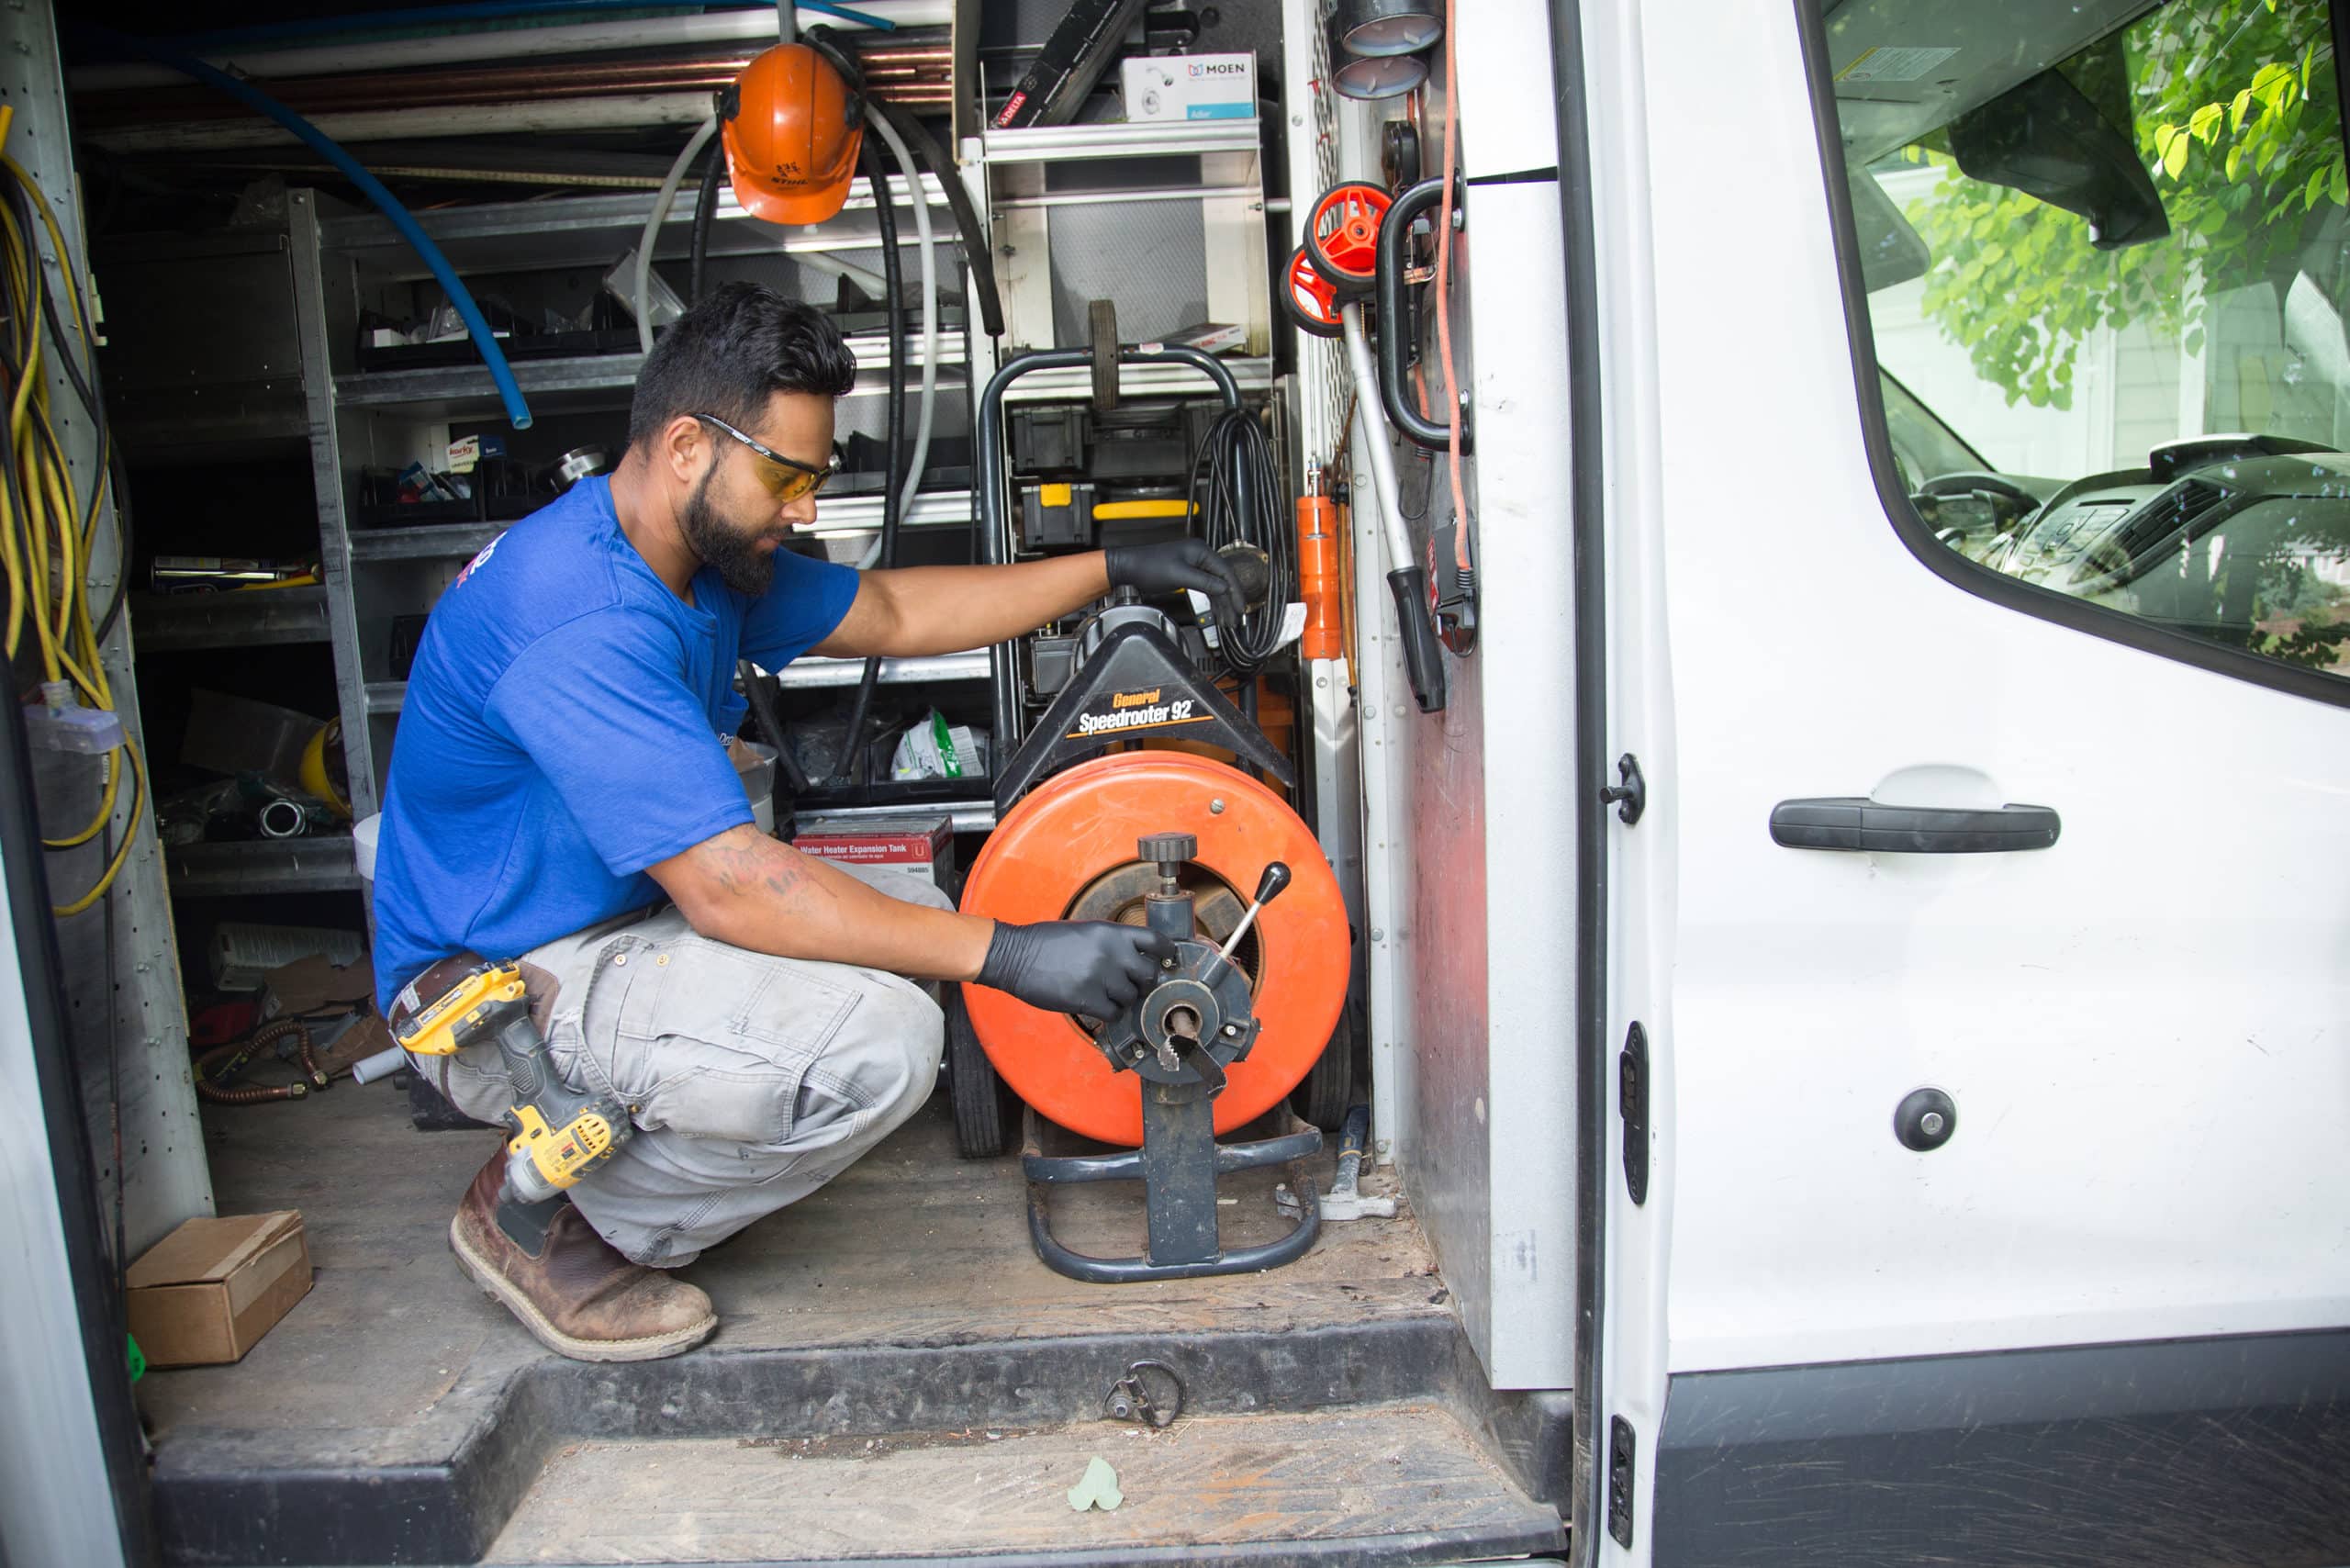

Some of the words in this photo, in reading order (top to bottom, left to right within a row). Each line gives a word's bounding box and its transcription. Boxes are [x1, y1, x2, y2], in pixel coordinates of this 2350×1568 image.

[1206, 63, 1245, 74] MOEN
[1005, 95, 1024, 117] DELTA
[449, 445, 474, 455] korky
[1113, 689, 1161, 709] General
[1079, 705, 1169, 735] Speedrooter
[1171, 700, 1192, 720] 92
[800, 846, 822, 854] Water
[823, 845, 847, 854] Heater
[849, 844, 887, 855] Expansion
[889, 844, 907, 852] Tank
